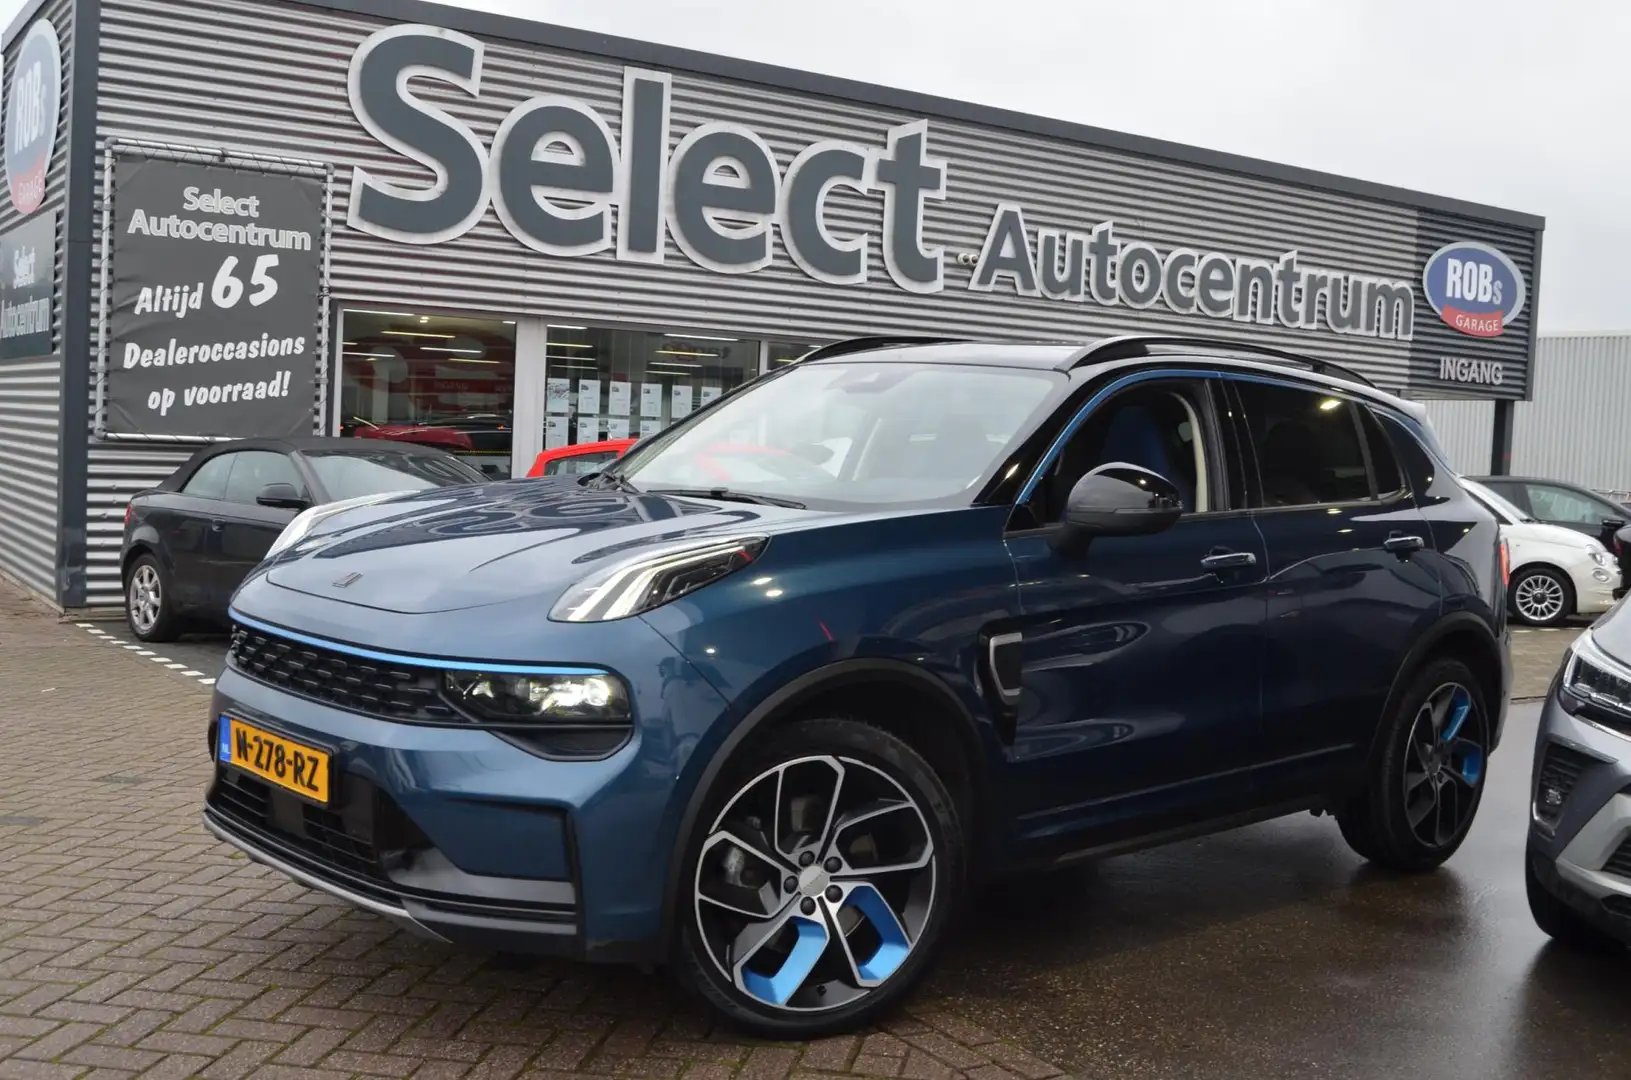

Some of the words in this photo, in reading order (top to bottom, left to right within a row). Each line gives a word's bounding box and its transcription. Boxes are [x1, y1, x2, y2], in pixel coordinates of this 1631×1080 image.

[347, 23, 947, 294] Select
[182, 186, 260, 218] Select
[127, 208, 312, 251] Autocentrum
[134, 281, 205, 319] Altijd
[211, 253, 280, 309] 65
[968, 203, 1415, 341] Autocentrum
[1455, 313, 1500, 332] GARAGE
[123, 332, 306, 369] Dealeroccasions
[1439, 355, 1504, 386] INGANG
[147, 387, 176, 417] op
[183, 369, 292, 407] voorraad!
[236, 727, 320, 793] N-278-RZ
